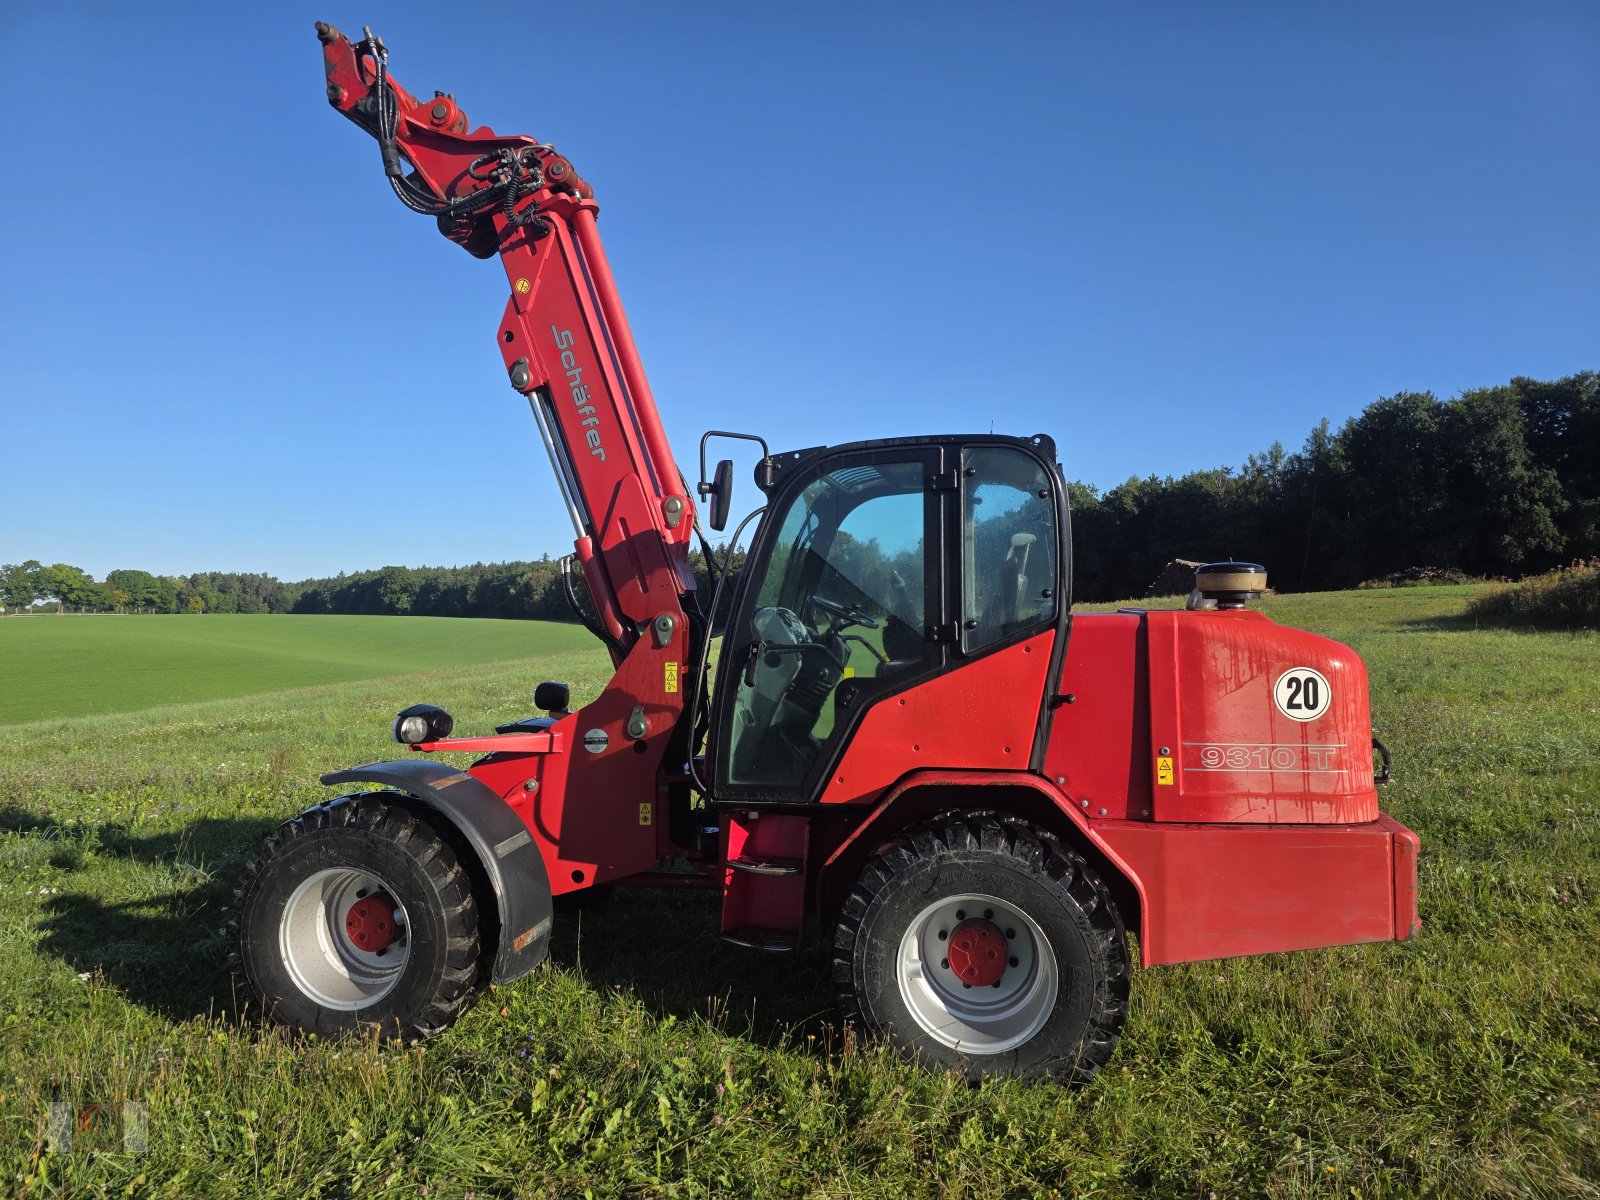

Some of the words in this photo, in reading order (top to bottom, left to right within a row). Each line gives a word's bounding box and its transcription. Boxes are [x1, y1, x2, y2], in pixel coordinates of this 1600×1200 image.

[551, 324, 606, 462] Schäffer
[1286, 676, 1319, 710] 20
[1201, 746, 1296, 769] 9310
[1309, 748, 1336, 769] T
